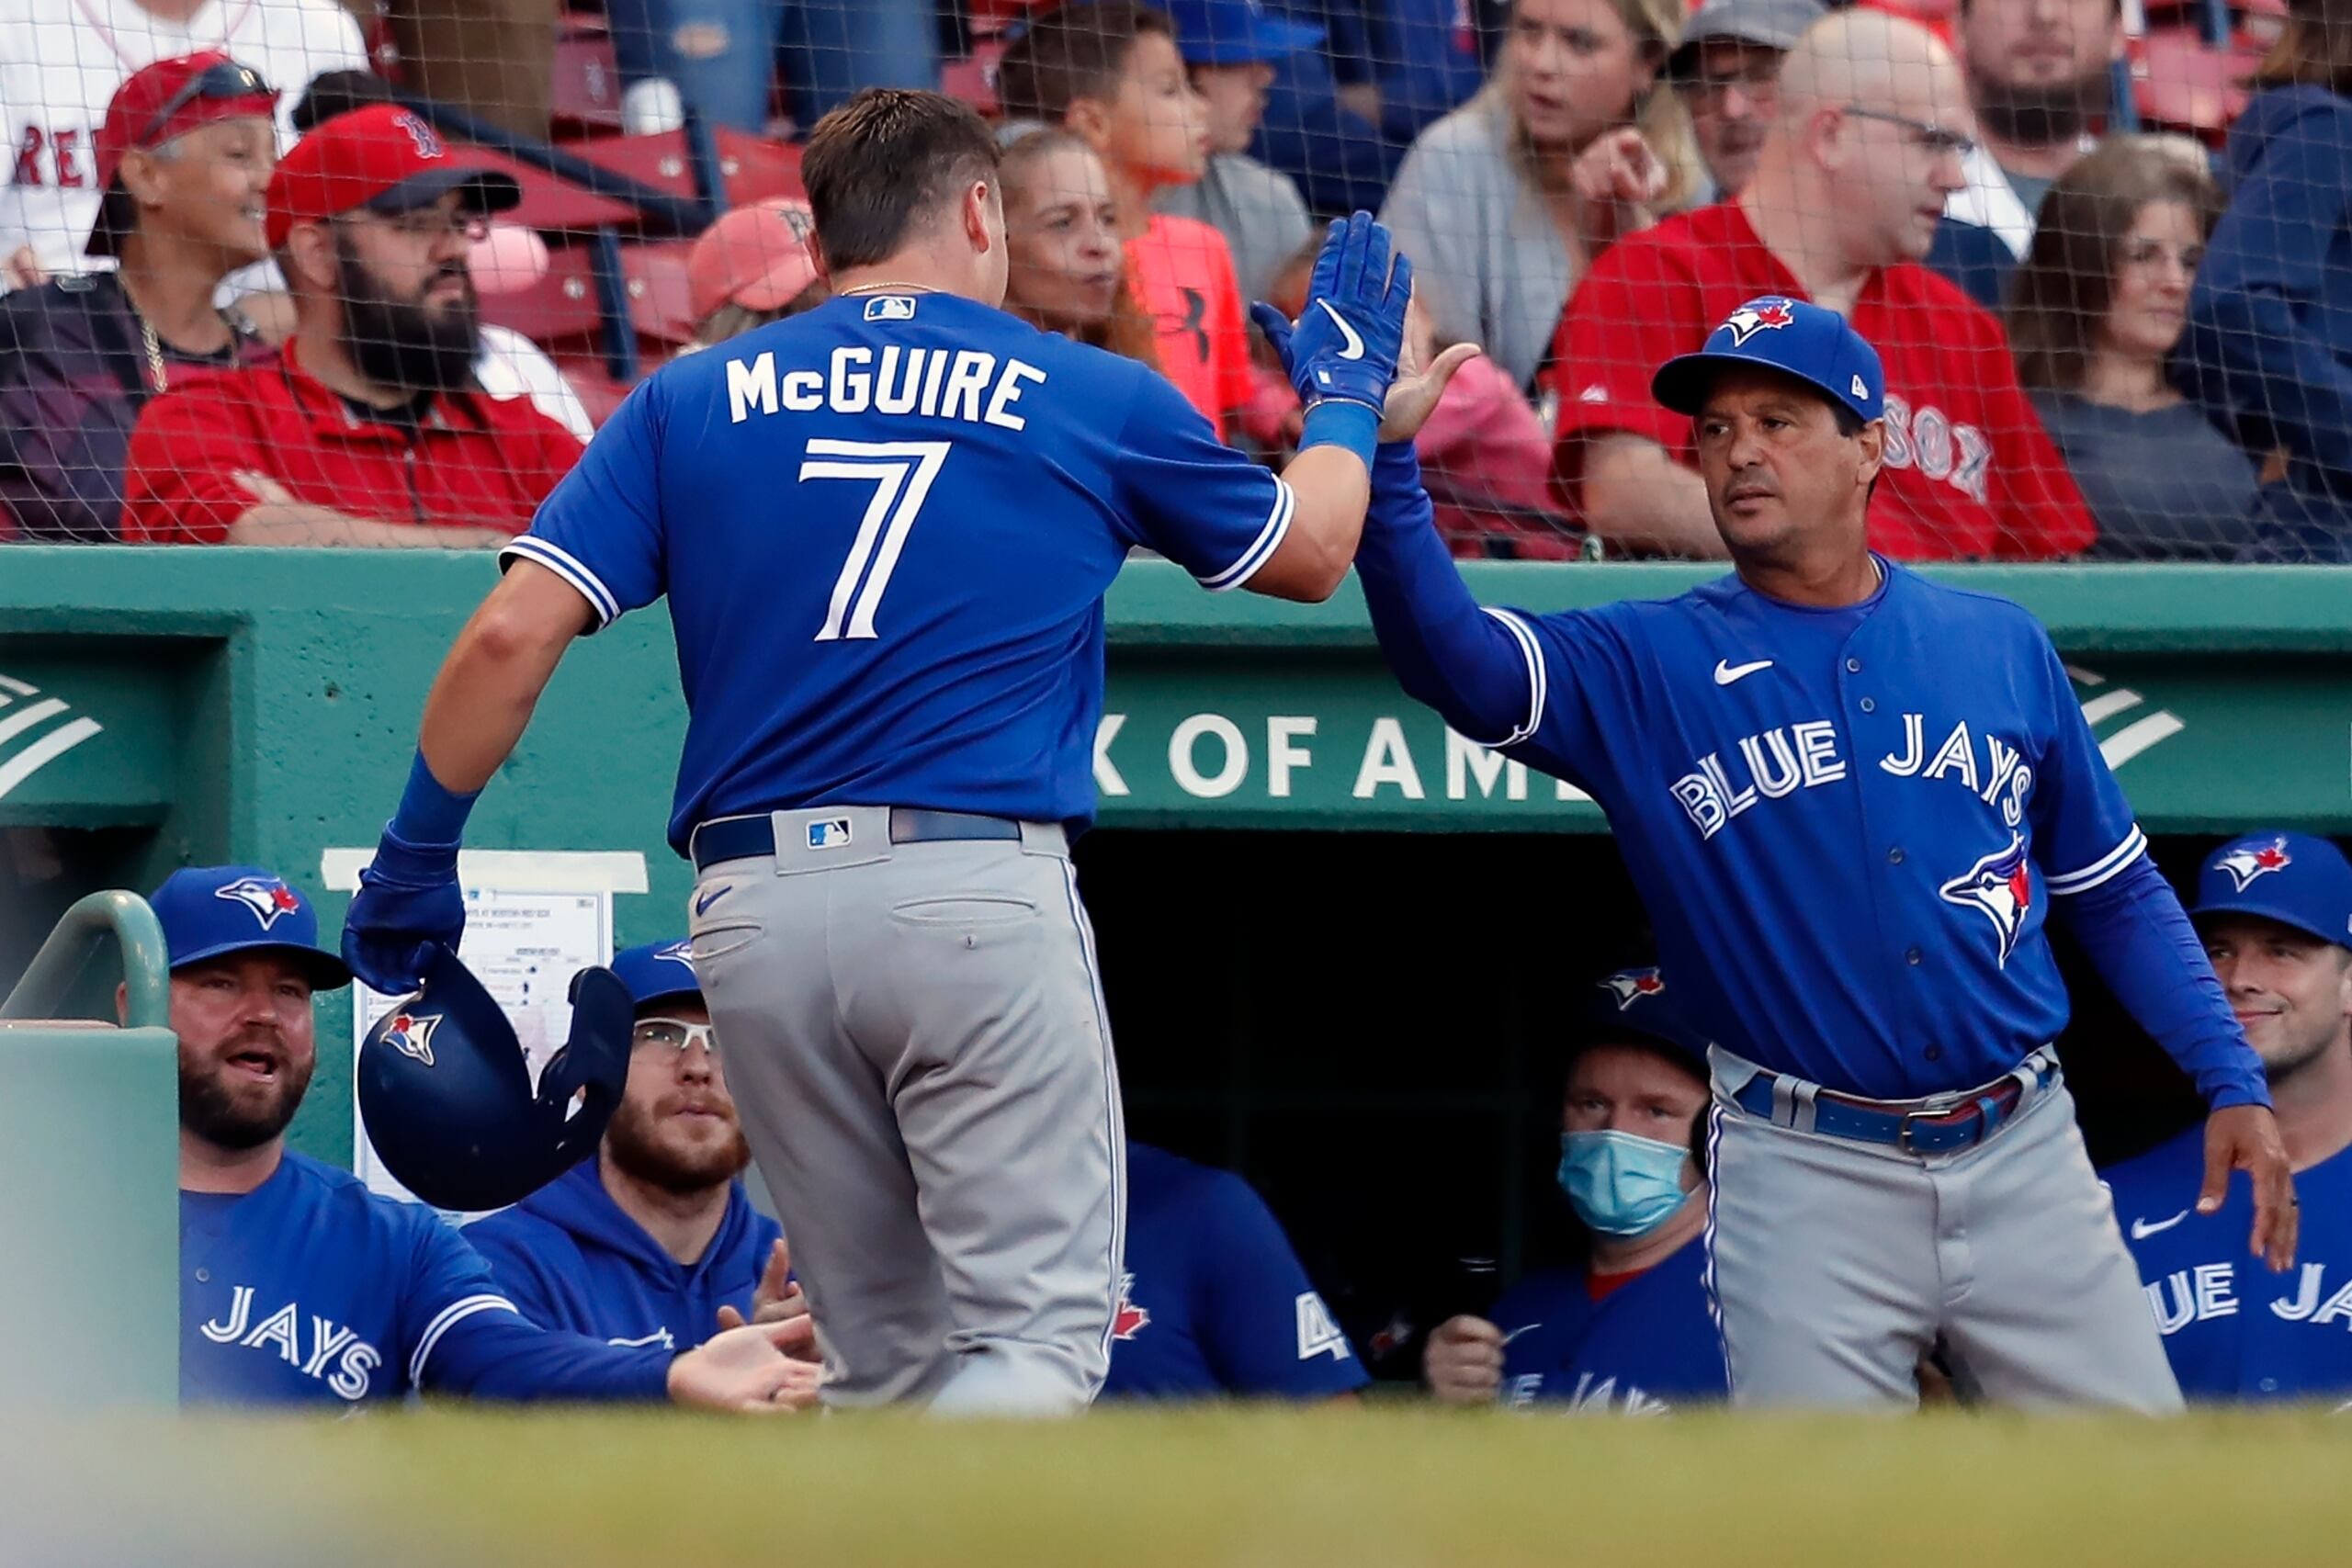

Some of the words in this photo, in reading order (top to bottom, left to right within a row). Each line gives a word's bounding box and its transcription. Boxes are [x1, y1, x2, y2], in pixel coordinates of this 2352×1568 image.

[726, 345, 1047, 432] McGUIRE
[798, 438, 952, 642] 7
[1168, 714, 1317, 797] OF
[1669, 720, 1847, 840] BLUE
[1880, 714, 2031, 827] JAYS
[200, 1286, 382, 1401] JAYS
[1295, 1292, 1351, 1361] 4
